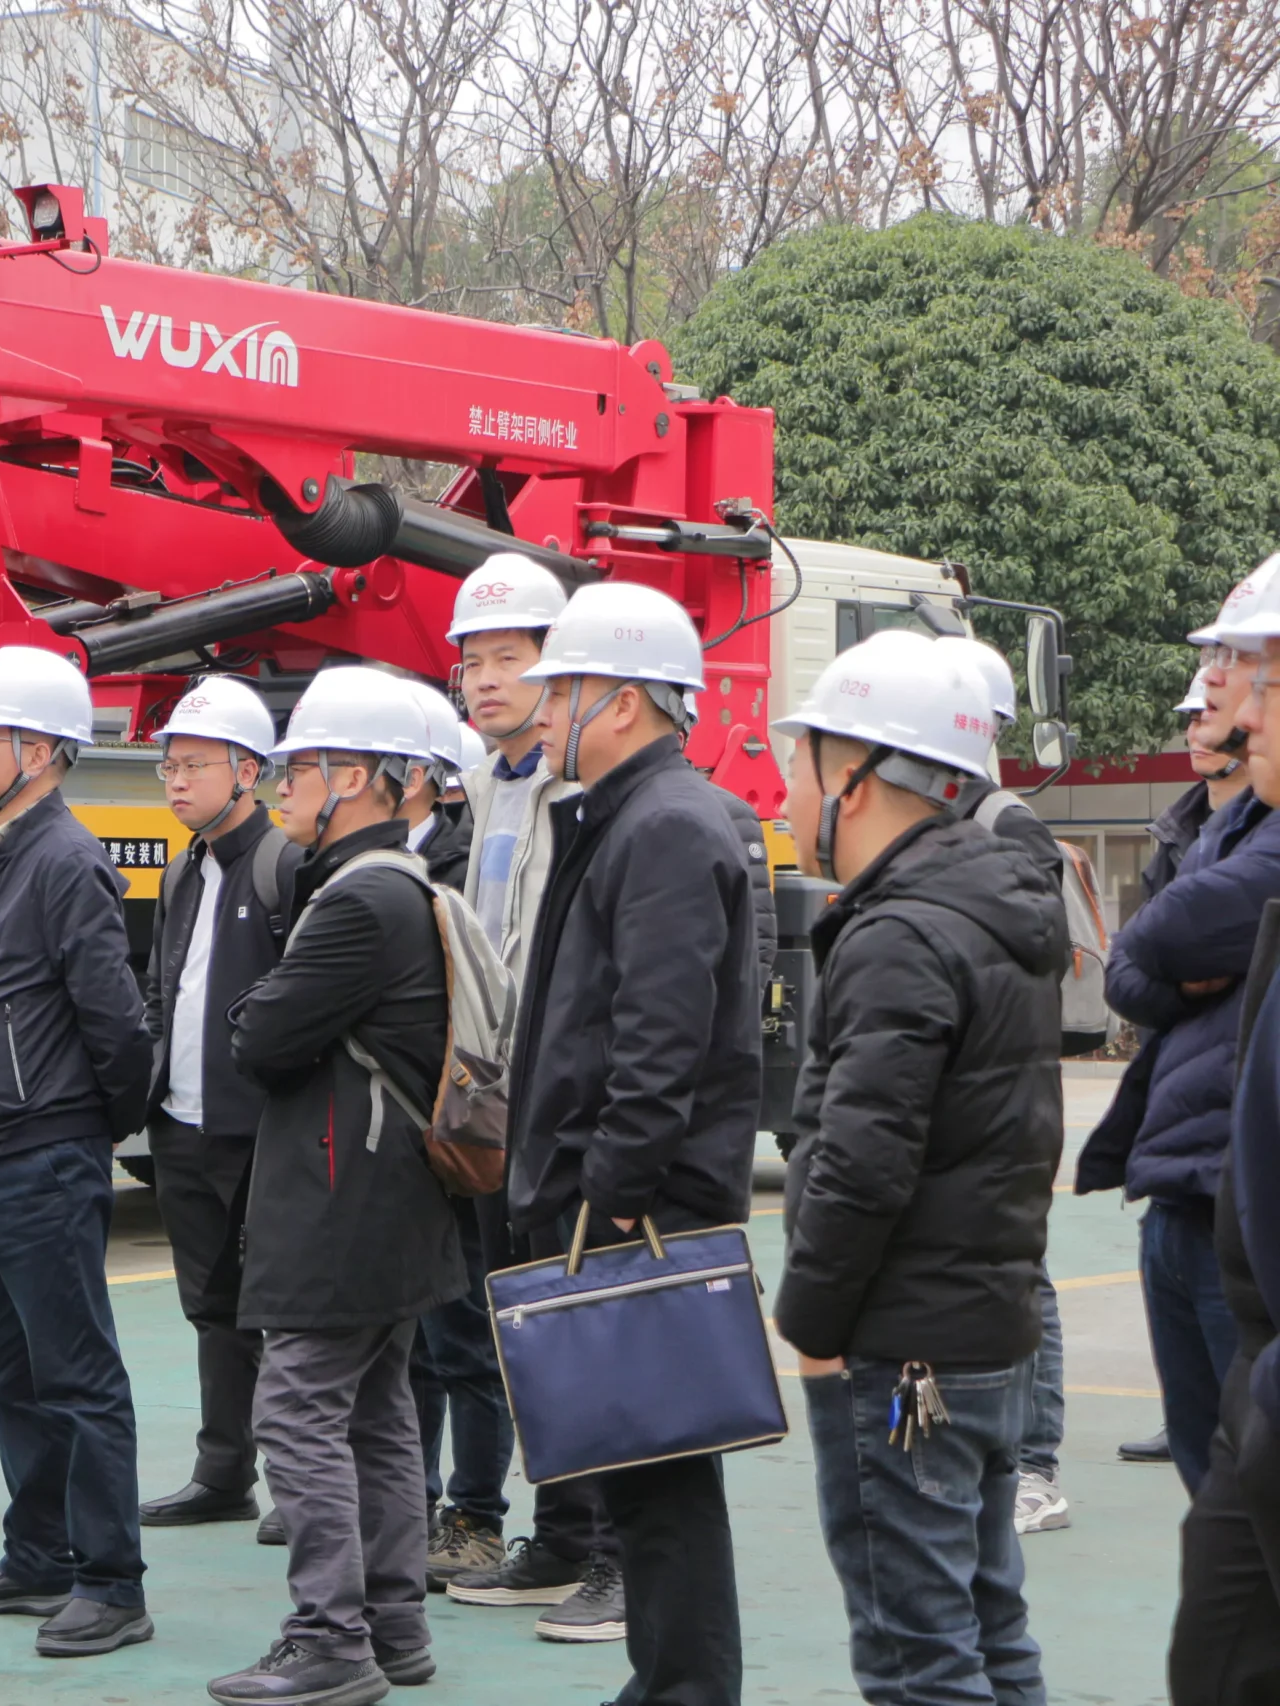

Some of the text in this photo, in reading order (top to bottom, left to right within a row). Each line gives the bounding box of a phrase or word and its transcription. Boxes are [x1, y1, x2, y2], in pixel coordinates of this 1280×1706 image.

[100, 305, 299, 387] WUXIN
[468, 404, 578, 449] 禁止臂架同侧作业
[614, 627, 644, 642] 013
[839, 679, 870, 698] 028
